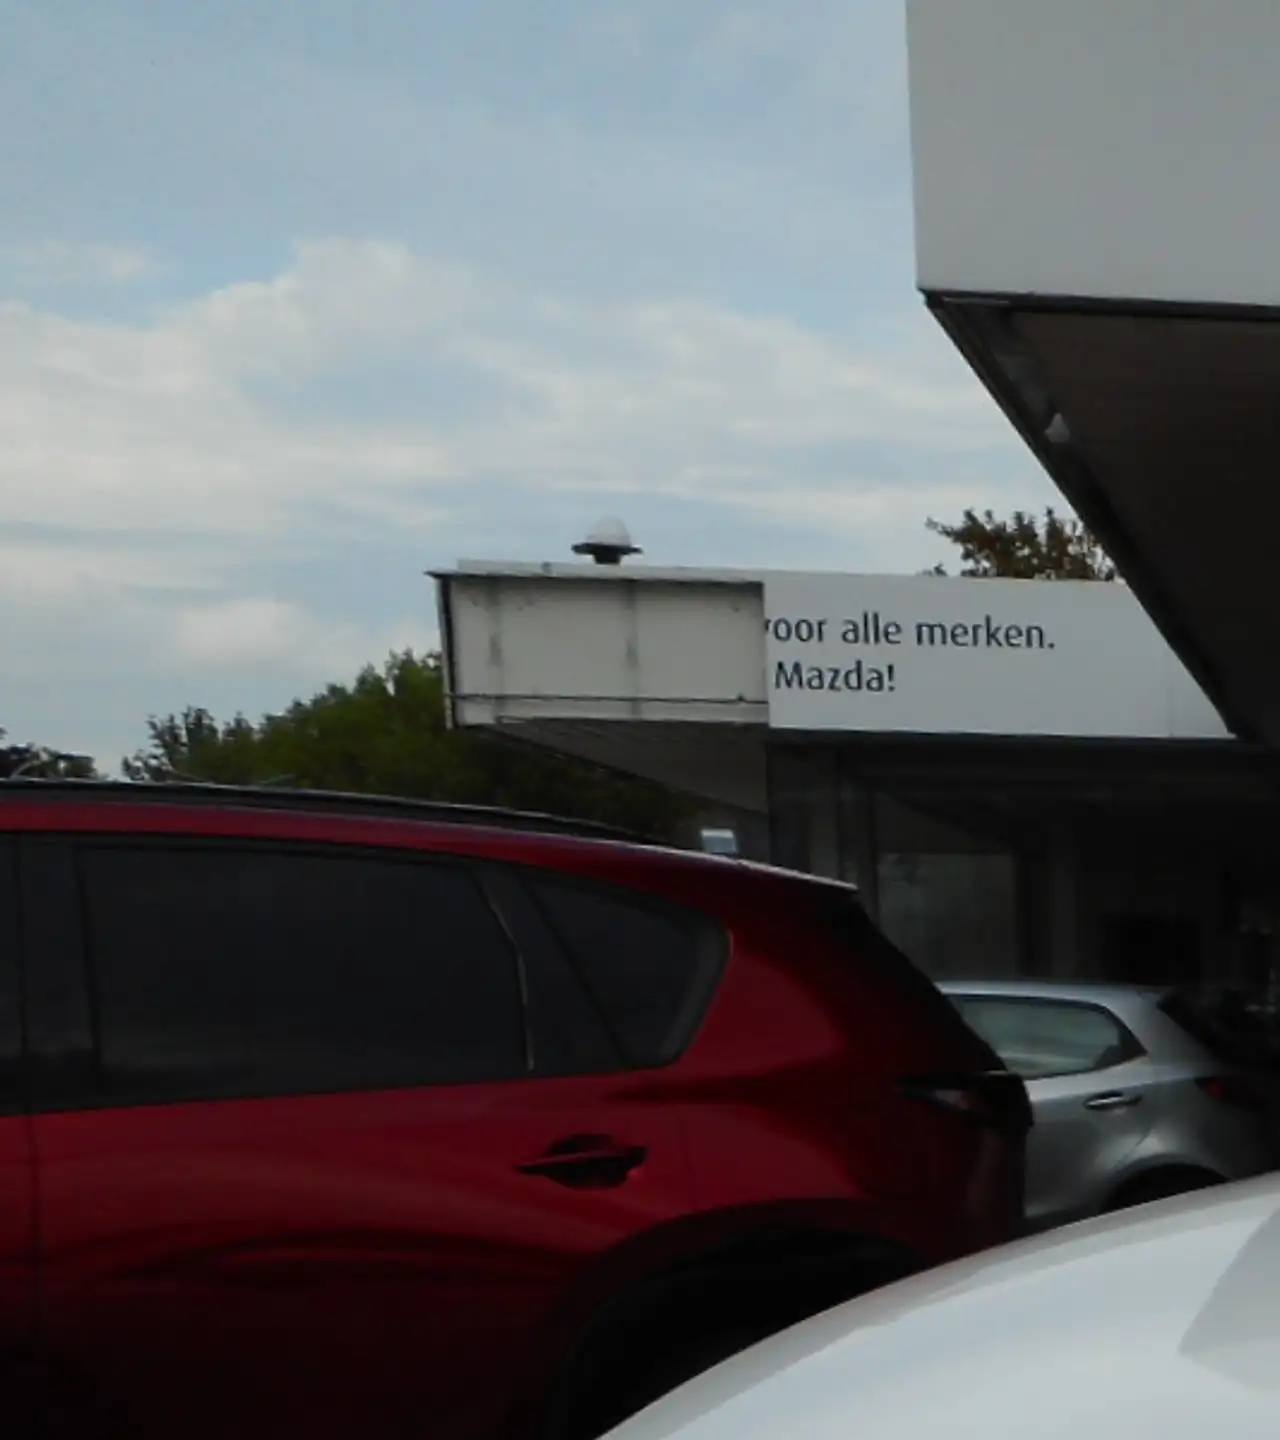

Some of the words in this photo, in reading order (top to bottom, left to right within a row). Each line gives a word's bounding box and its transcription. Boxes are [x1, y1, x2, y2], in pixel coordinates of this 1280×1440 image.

[841, 611, 902, 644] alle
[915, 614, 1056, 649] merken.
[774, 660, 896, 692] Mazda!
